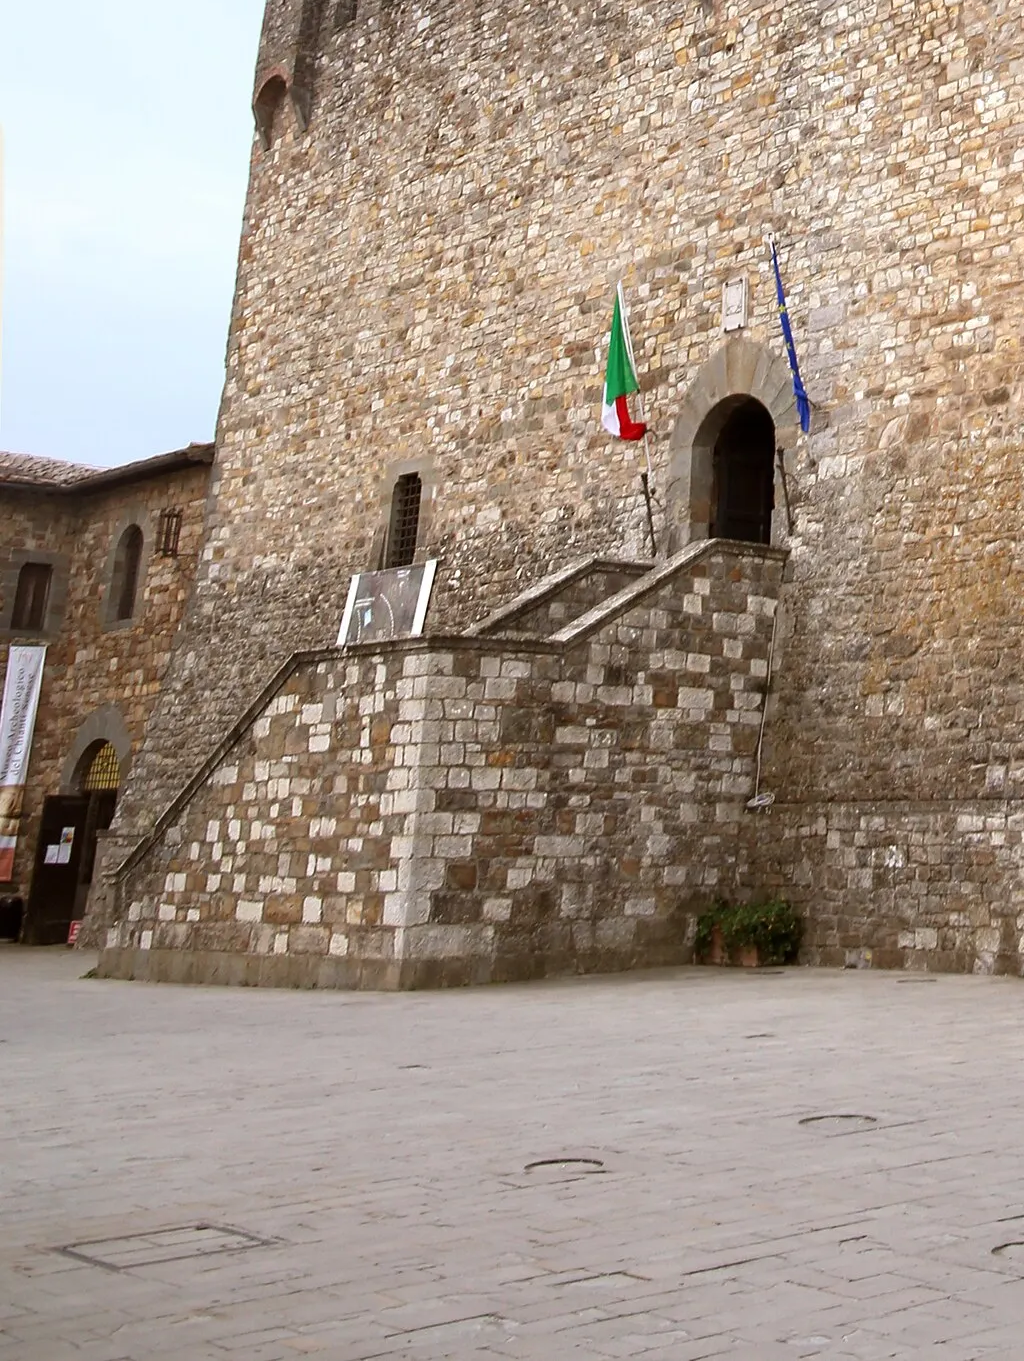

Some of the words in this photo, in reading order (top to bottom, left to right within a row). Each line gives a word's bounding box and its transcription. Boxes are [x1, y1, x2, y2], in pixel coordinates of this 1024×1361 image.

[8, 668, 25, 738] Archeologico
[15, 714, 26, 755] Chianti
[11, 758, 20, 775] del
